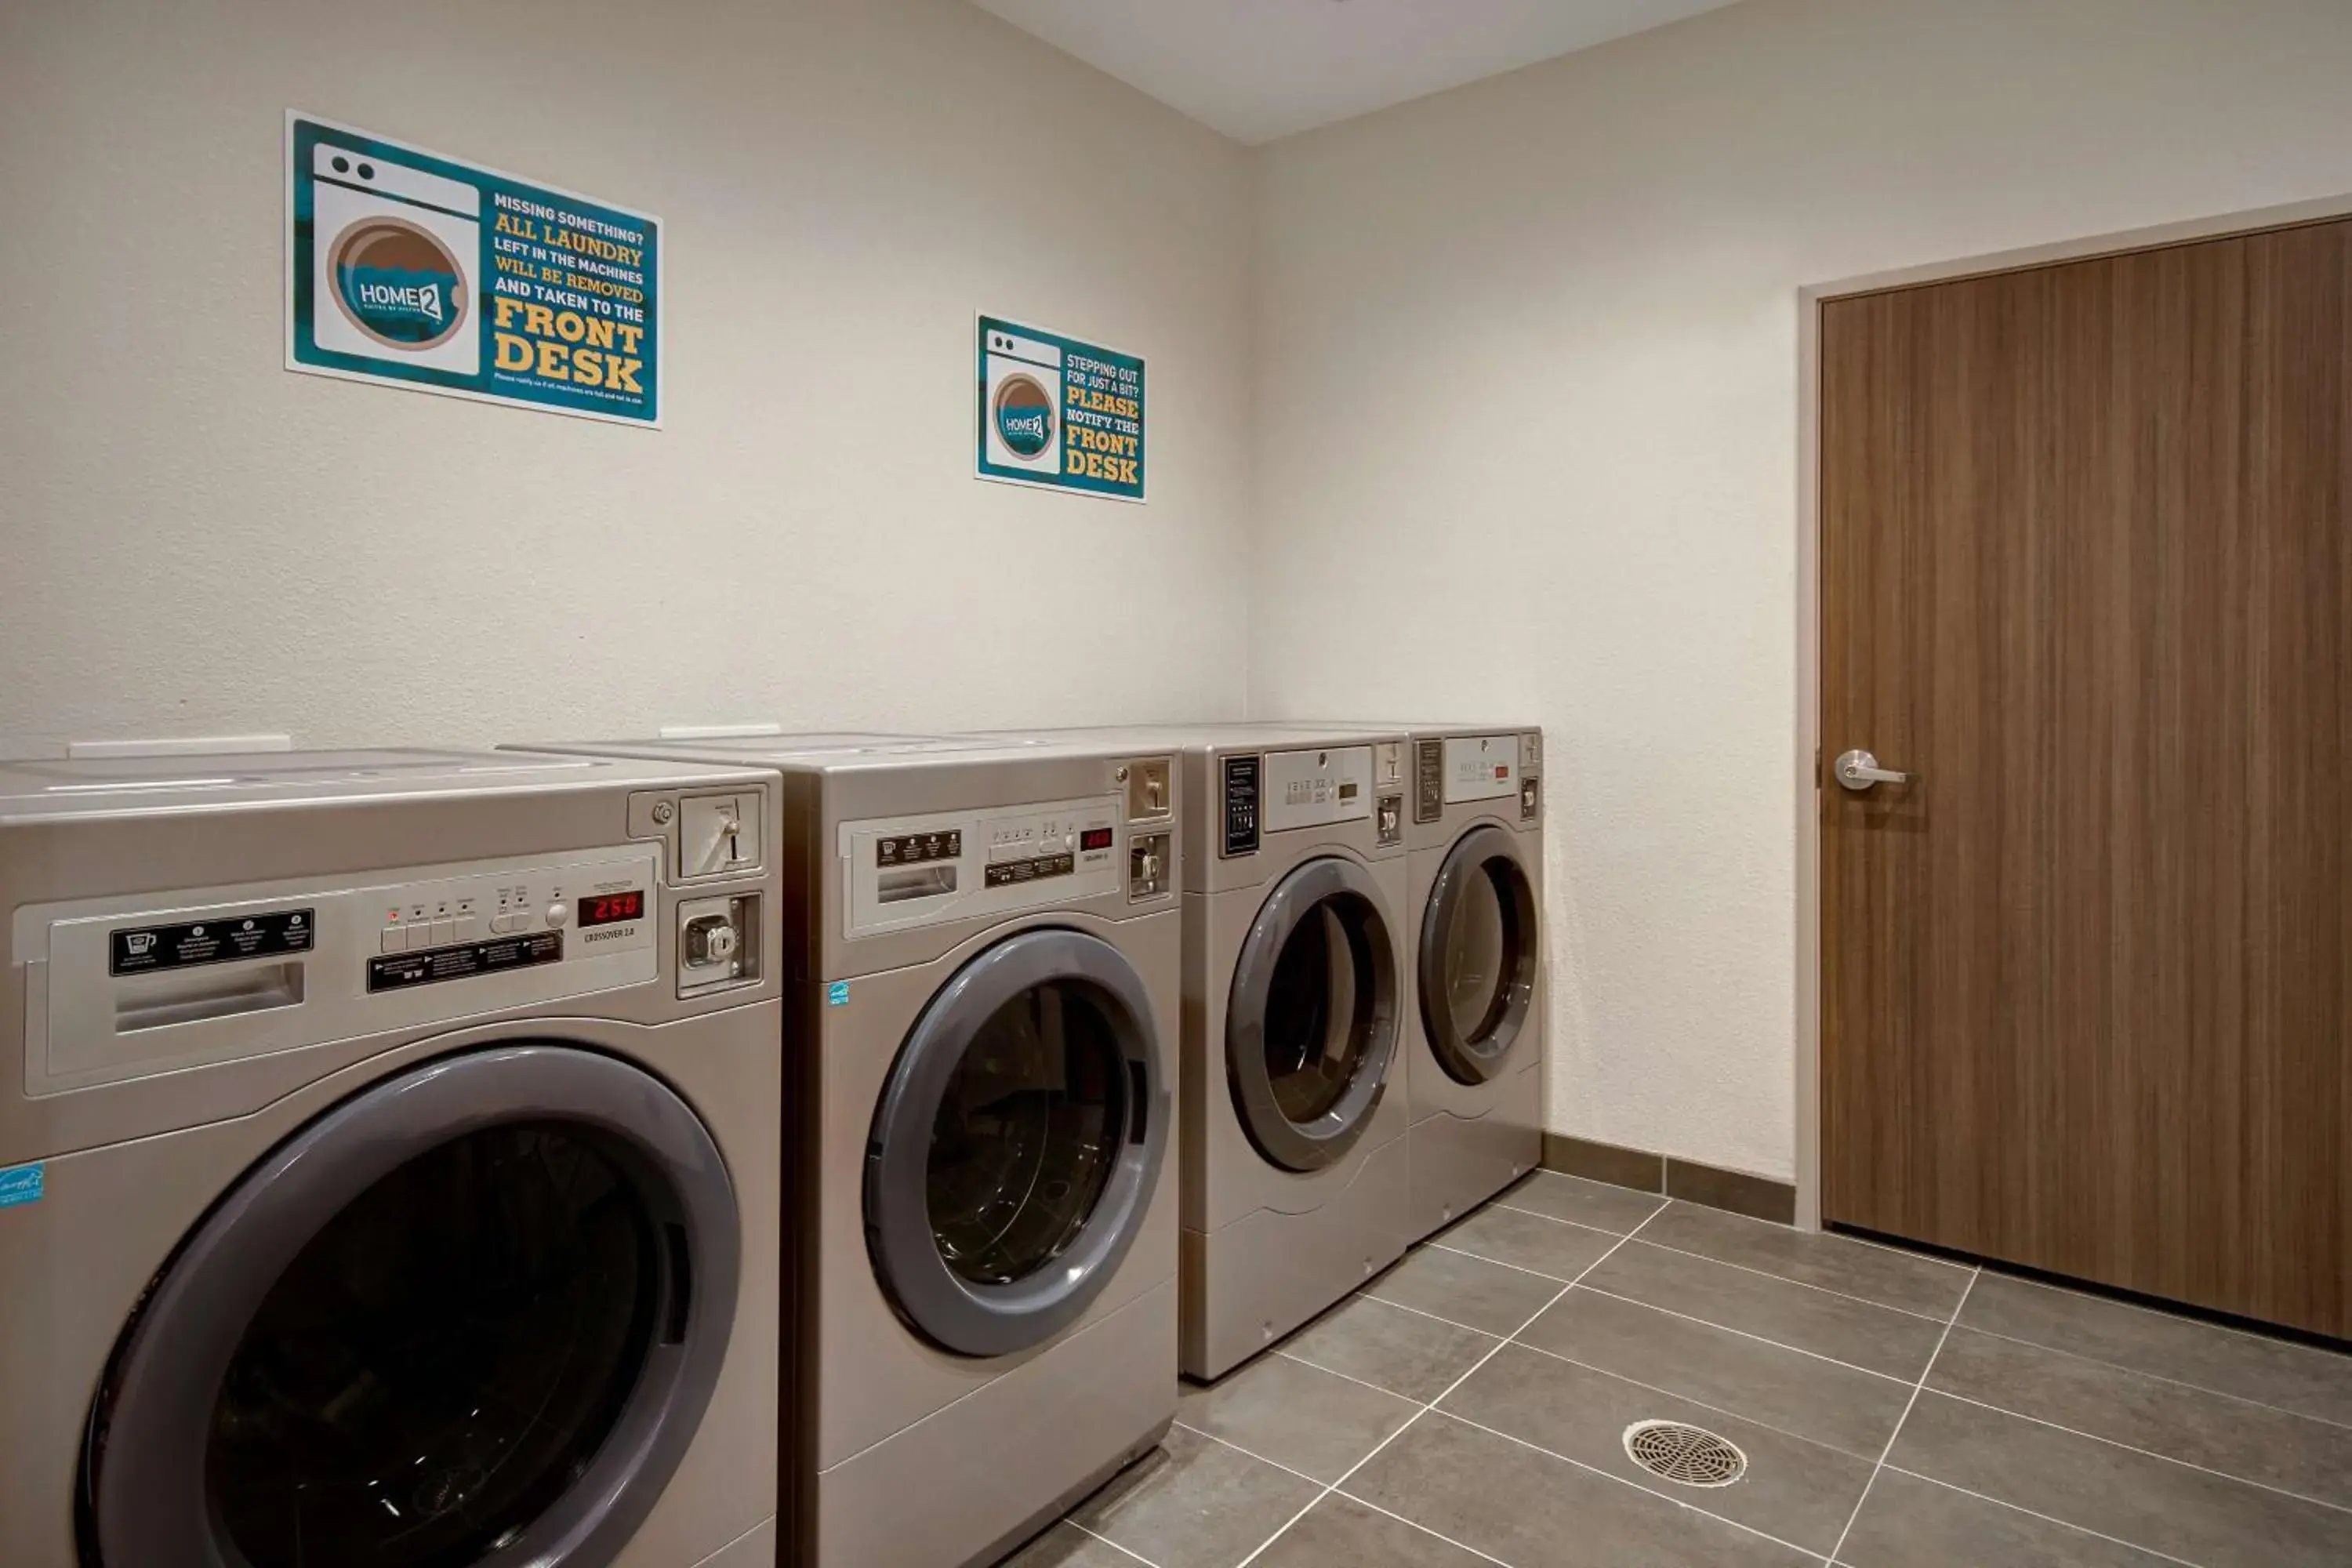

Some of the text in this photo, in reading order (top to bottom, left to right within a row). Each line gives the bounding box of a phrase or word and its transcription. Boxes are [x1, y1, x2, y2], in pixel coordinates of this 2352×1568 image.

[495, 193, 644, 245] MISSING SOMETHING?
[495, 212, 643, 267] ALL LAUNDRY
[494, 237, 643, 285] LEFT IN THE MACHINES
[495, 255, 644, 303] WILL BE REMOVED
[495, 277, 644, 322] AND TAKEN TO THE
[494, 296, 644, 354] FRONT
[494, 332, 643, 394] DESK
[1067, 354, 1138, 384] STEPPING OUT
[1067, 370, 1139, 397] FOR JUST A BIT?
[1066, 385, 1139, 419] PLEASE
[1067, 408, 1139, 435] NOTIFY THE
[1066, 424, 1138, 457] FRONT
[1066, 448, 1138, 485] DESK
